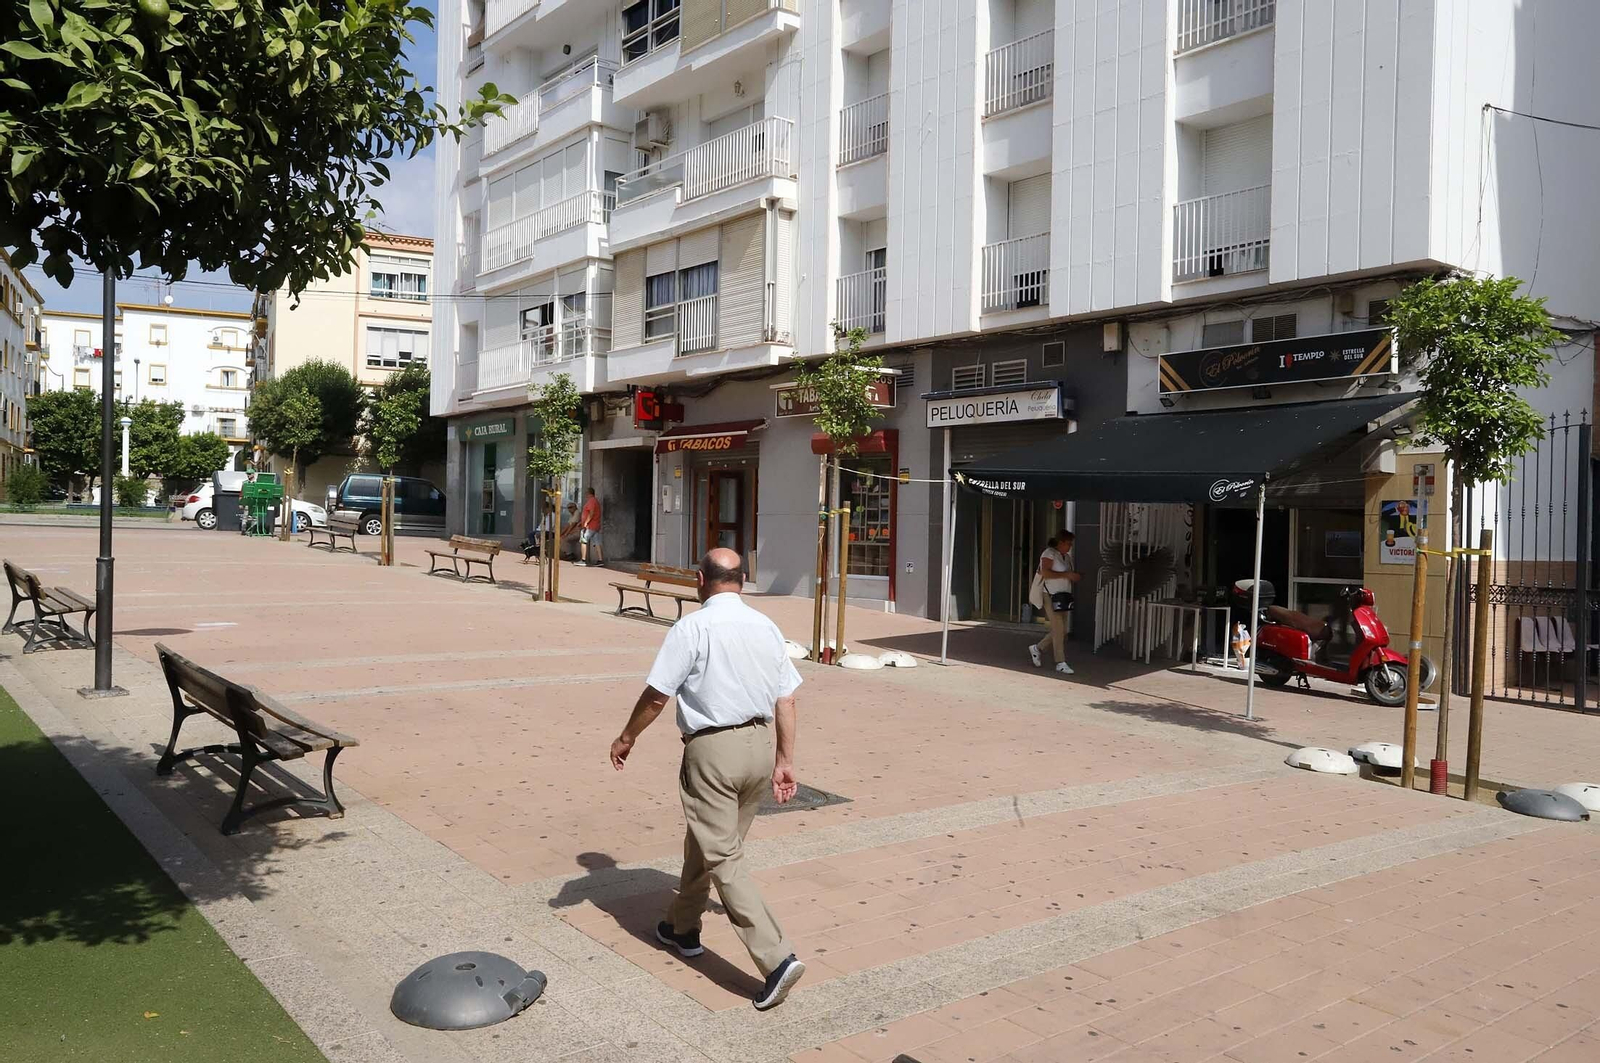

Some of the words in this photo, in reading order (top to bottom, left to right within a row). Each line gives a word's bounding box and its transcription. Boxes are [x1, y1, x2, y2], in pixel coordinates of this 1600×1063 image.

[1342, 347, 1365, 355] ESTRELLA
[1353, 352, 1364, 360] SUR
[1279, 355, 1286, 368] I
[1293, 350, 1325, 362] TEMPLO
[931, 396, 1019, 421] PELUQUERÍA
[474, 425, 488, 436] CAJA
[488, 423, 507, 435] RURAL
[679, 436, 732, 450] TABACOS
[1000, 481, 1011, 490] DEL
[1012, 481, 1026, 491] SUR
[1389, 548, 1415, 556] VICTORI
